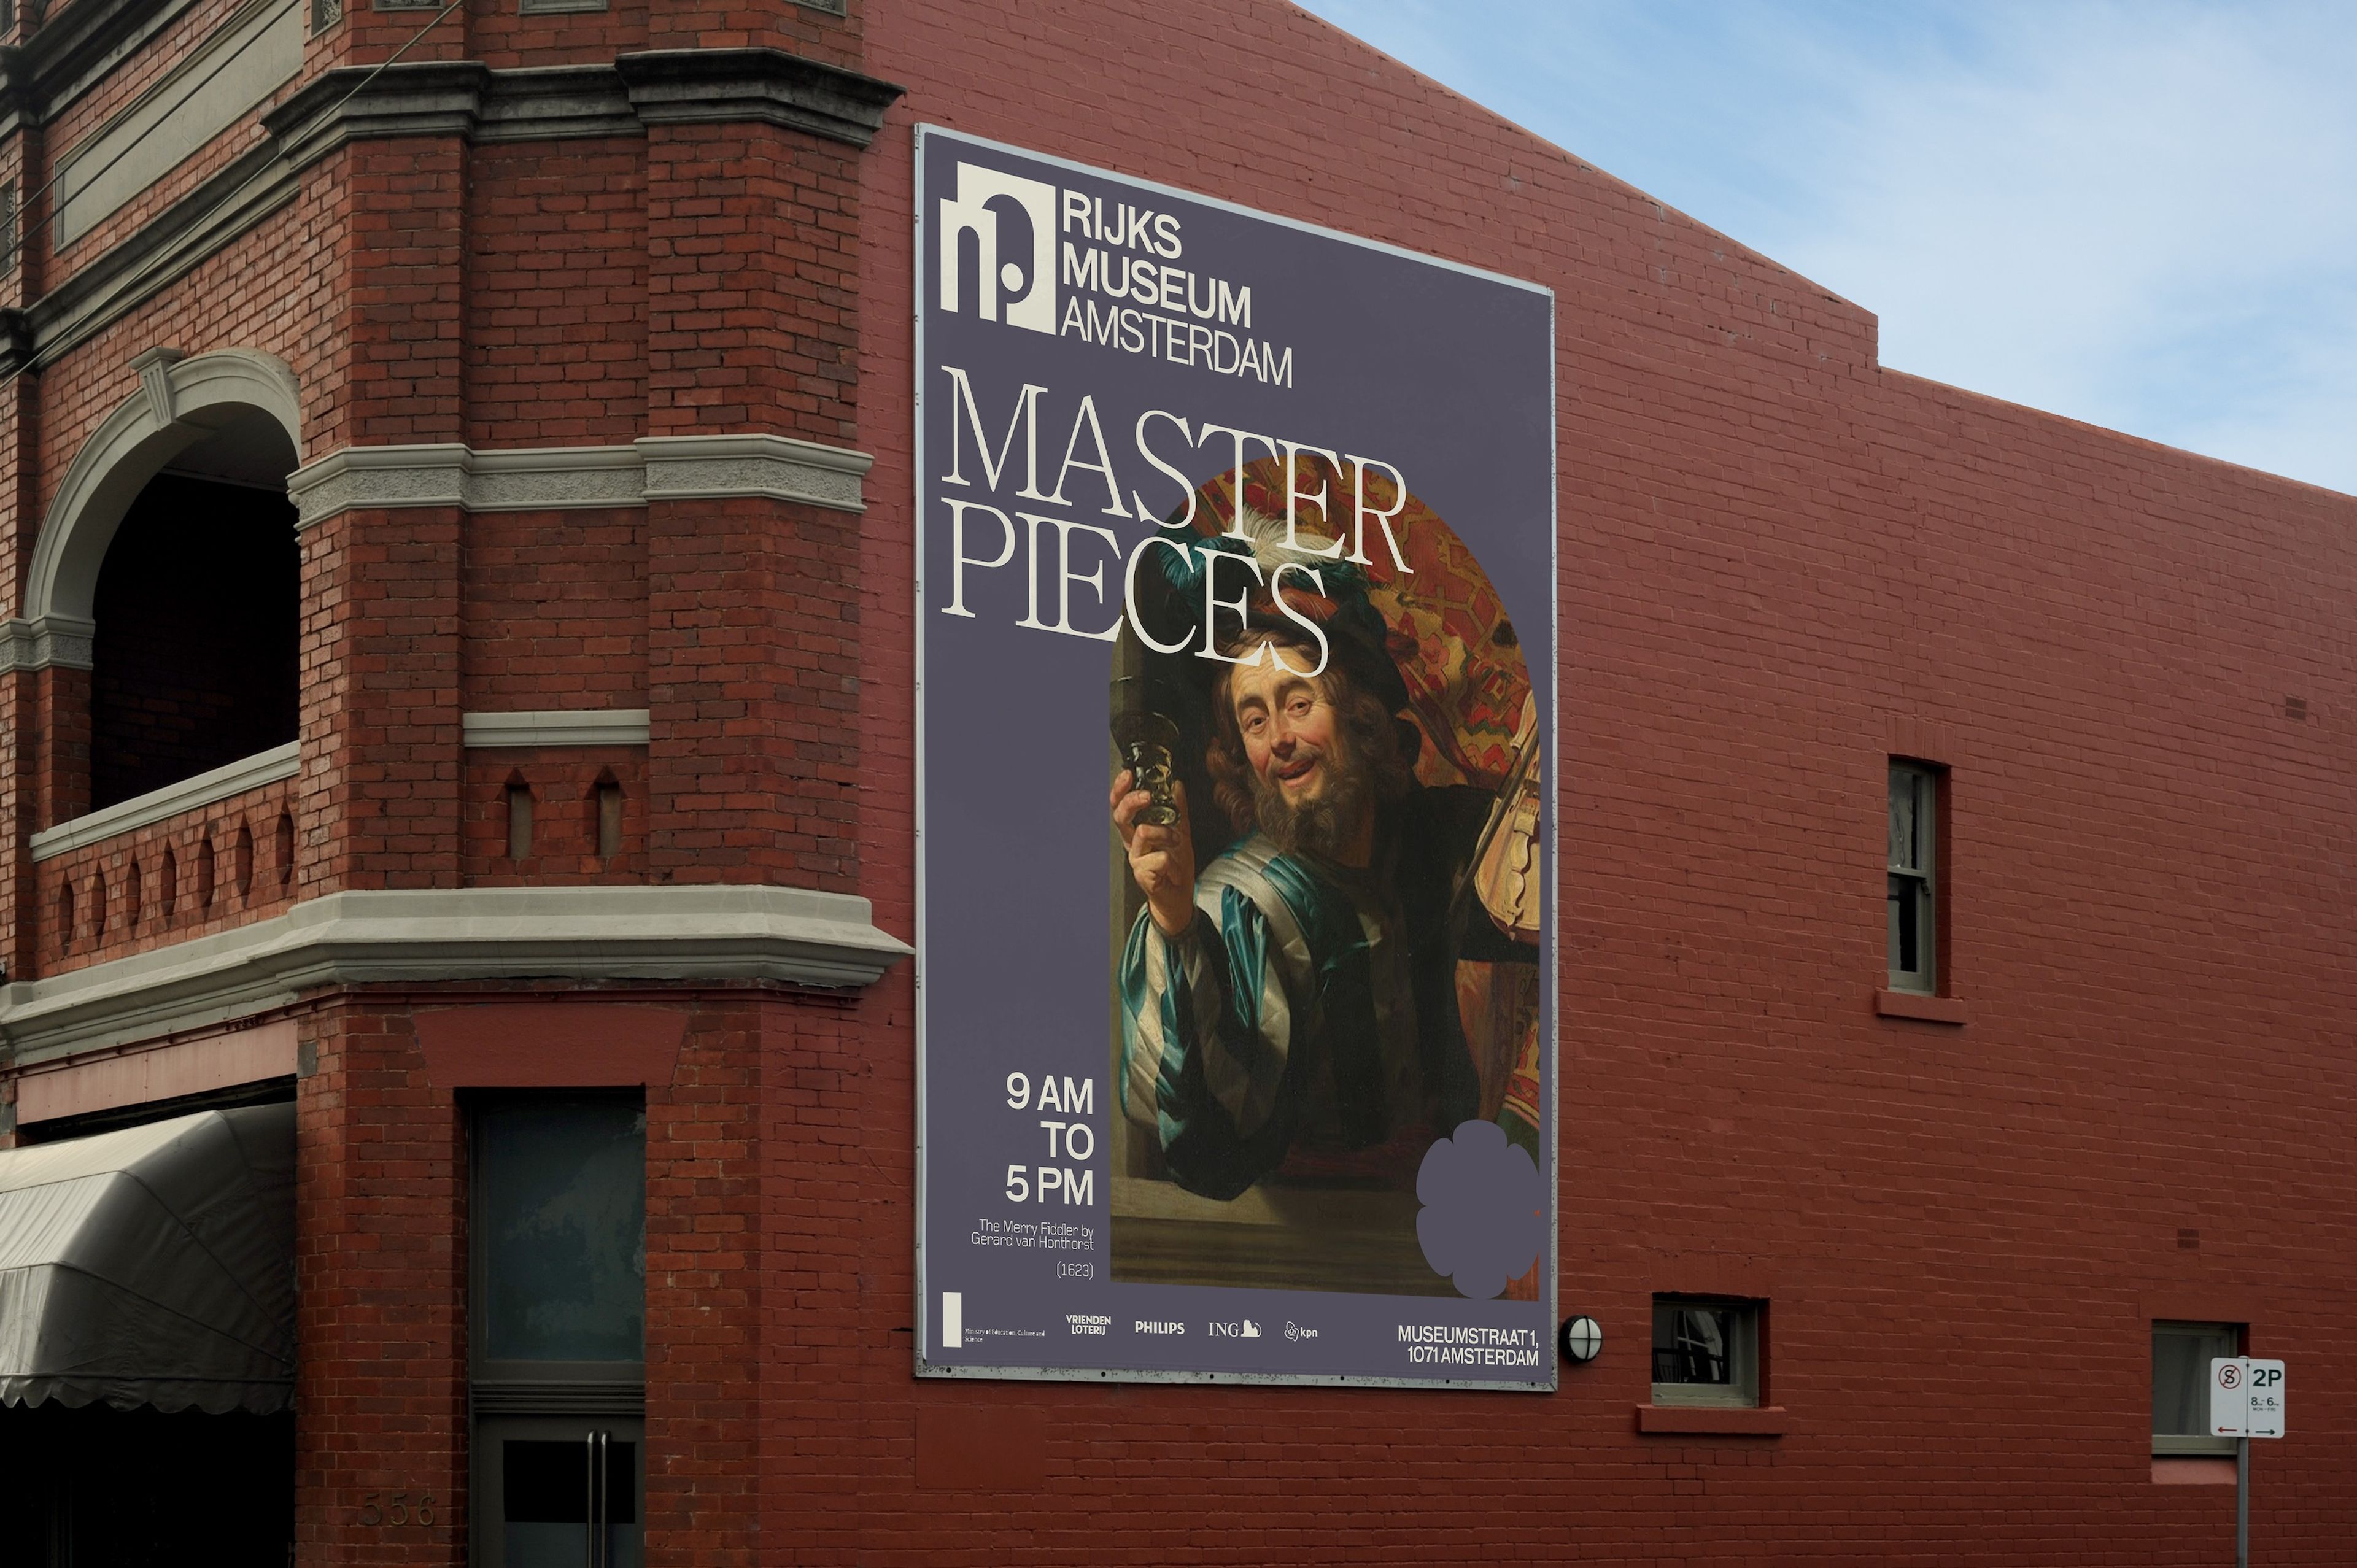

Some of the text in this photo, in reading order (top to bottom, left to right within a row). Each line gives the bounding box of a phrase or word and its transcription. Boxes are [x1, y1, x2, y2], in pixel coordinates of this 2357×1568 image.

[1064, 189, 1182, 259] RIJKS
[1064, 241, 1251, 328] MUSEUM
[1060, 296, 1292, 389] AMSTERDAM
[942, 365, 1414, 573] MASTER
[942, 497, 1329, 678] PIECES
[1006, 1072, 1093, 1114] 9 AM
[1040, 1121, 1094, 1161] TO
[1005, 1164, 1093, 1206] 5 PM
[979, 1218, 1094, 1240] The Merry Fiddler by
[971, 1232, 1094, 1251] Gerard van Honthorst
[1056, 1261, 1094, 1280] (1623)
[1066, 1314, 1112, 1325] VRIENDEN
[1072, 1324, 1106, 1335] LOTERIJ
[1136, 1320, 1185, 1335] PHILIPS
[1208, 1322, 1240, 1337] ING
[964, 1327, 985, 1336] Ministry
[1300, 1327, 1318, 1339] kpn
[1398, 1324, 1539, 1350] MUSEUMSTRAAT 1,
[1407, 1346, 1539, 1367] 1071 AMSTERDAM
[2252, 1369, 2282, 1387] 2P
[363, 1493, 436, 1526] 556
